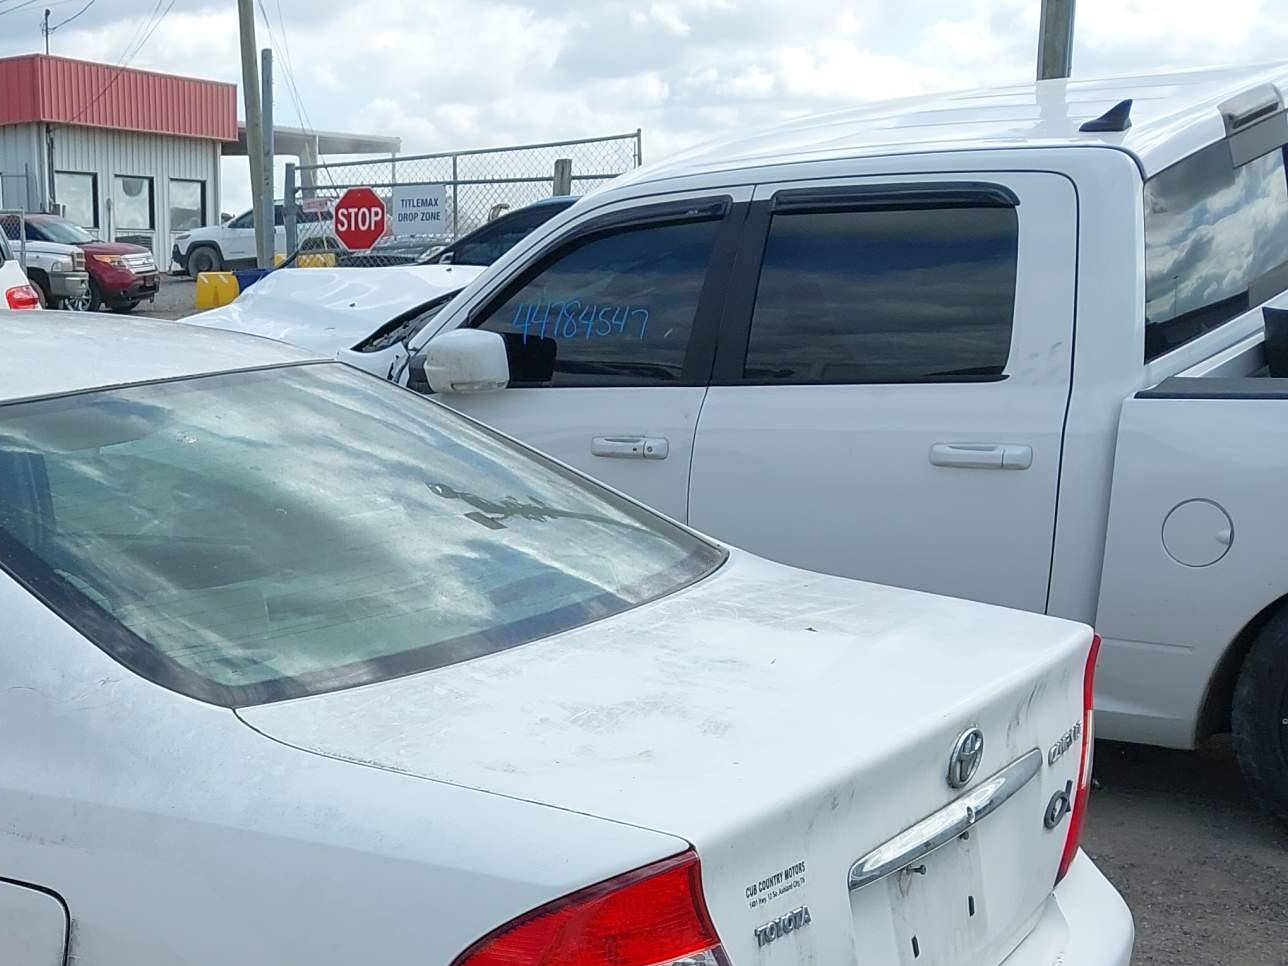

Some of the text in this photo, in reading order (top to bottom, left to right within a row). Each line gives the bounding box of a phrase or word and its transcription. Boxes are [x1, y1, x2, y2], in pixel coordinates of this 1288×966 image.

[337, 207, 382, 232] STOP
[398, 211, 440, 222] DROP ZONE
[400, 198, 439, 209] TITLEMAX
[513, 300, 649, 344] 44784547
[745, 860, 806, 899] CUB COUNTRY MOTORS
[754, 904, 812, 948] TOYOTA
